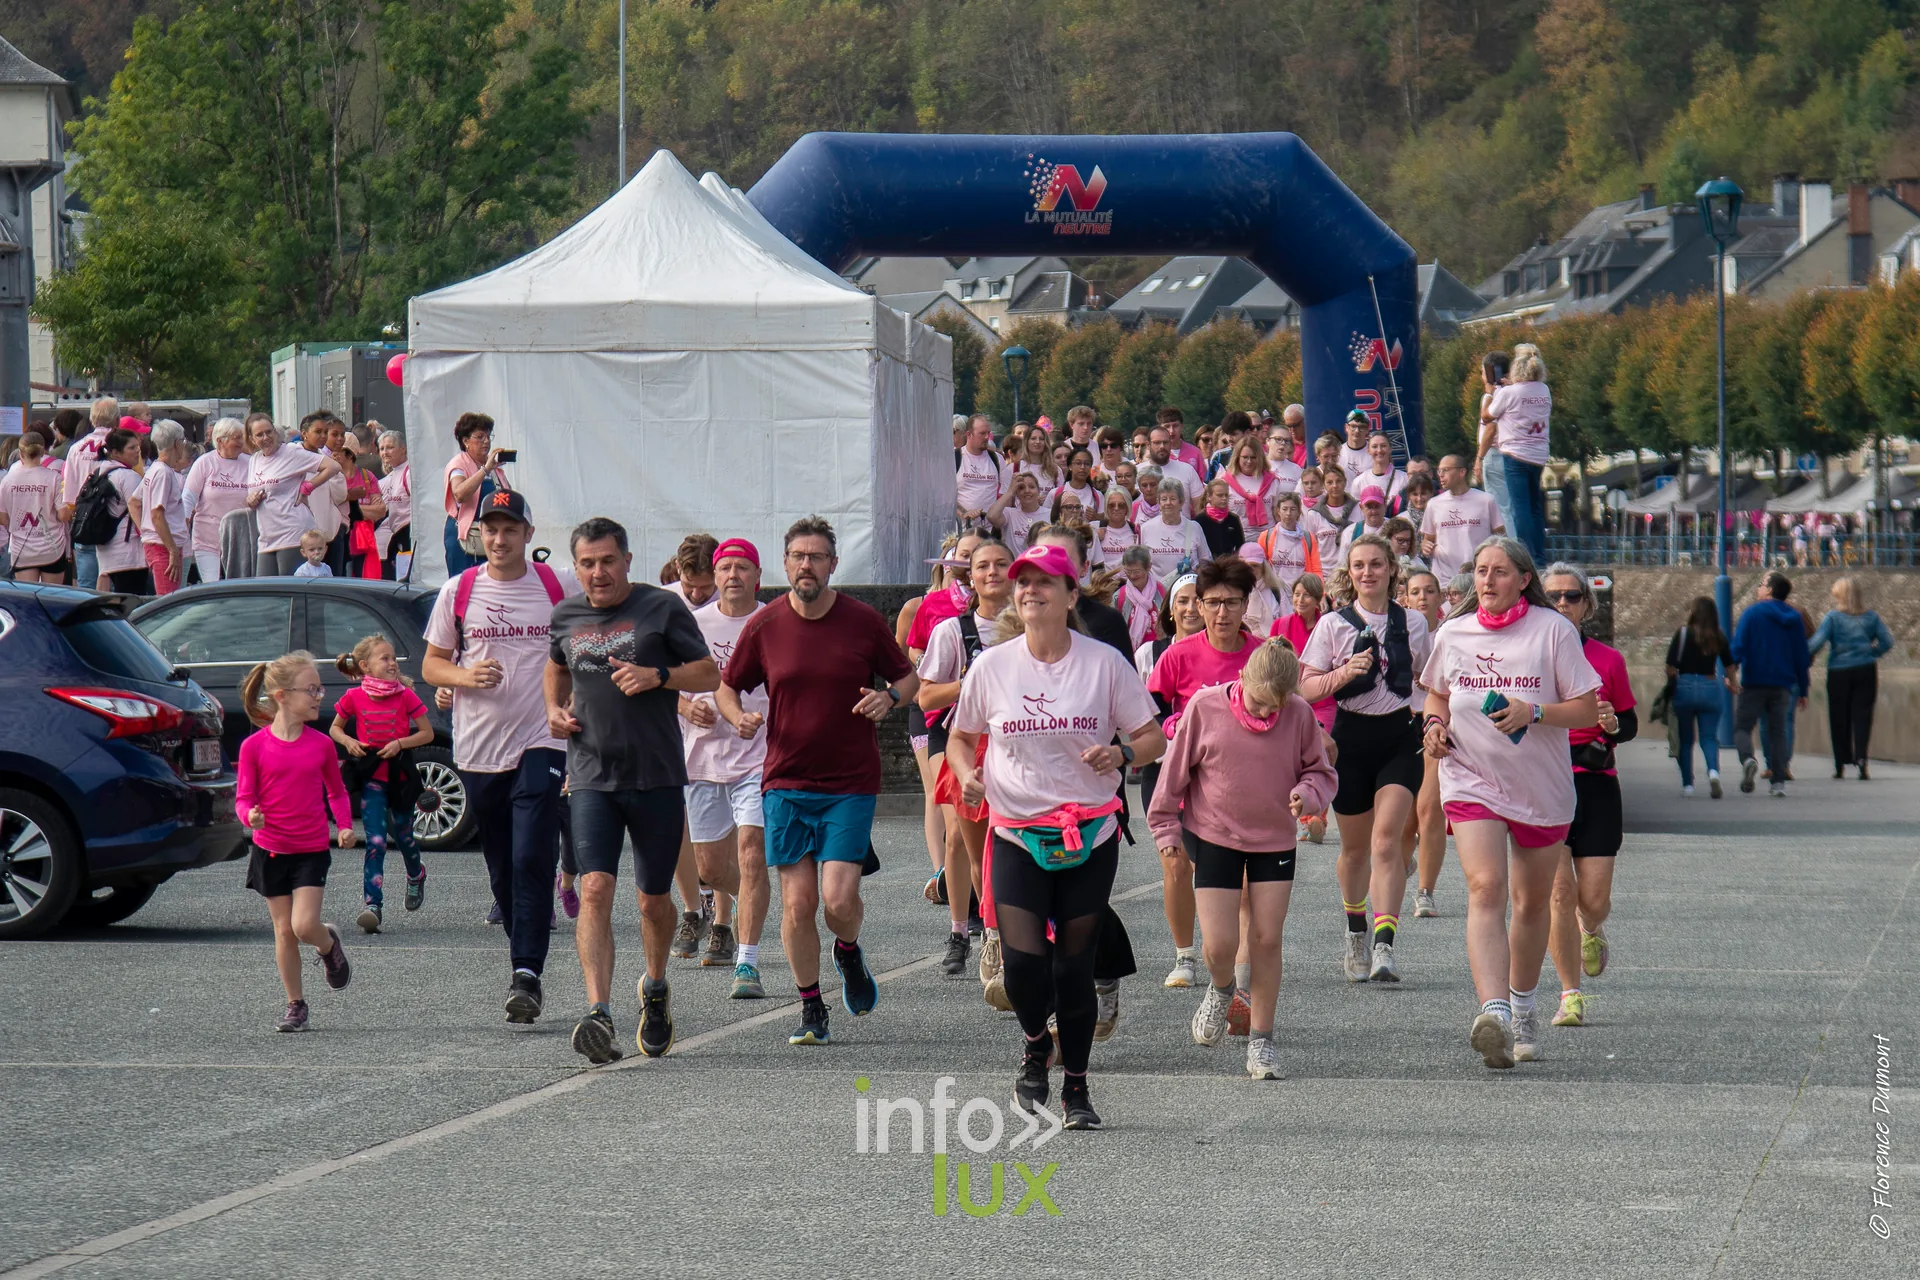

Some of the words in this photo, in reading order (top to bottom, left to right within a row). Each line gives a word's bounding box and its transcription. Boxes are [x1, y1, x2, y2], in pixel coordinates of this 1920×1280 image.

[1025, 211, 1040, 223] LA
[1044, 209, 1113, 223] MUTUALITÉ
[11, 484, 48, 493] PIERRET
[211, 480, 240, 489] BOUILLON
[1441, 519, 1467, 527] BOUILLON
[471, 624, 524, 639] BOUILLON
[1459, 675, 1512, 688] BOUILLON
[1515, 675, 1541, 688] ROSE
[1003, 717, 1068, 734] BOUILLON
[1072, 716, 1098, 730] ROSE
